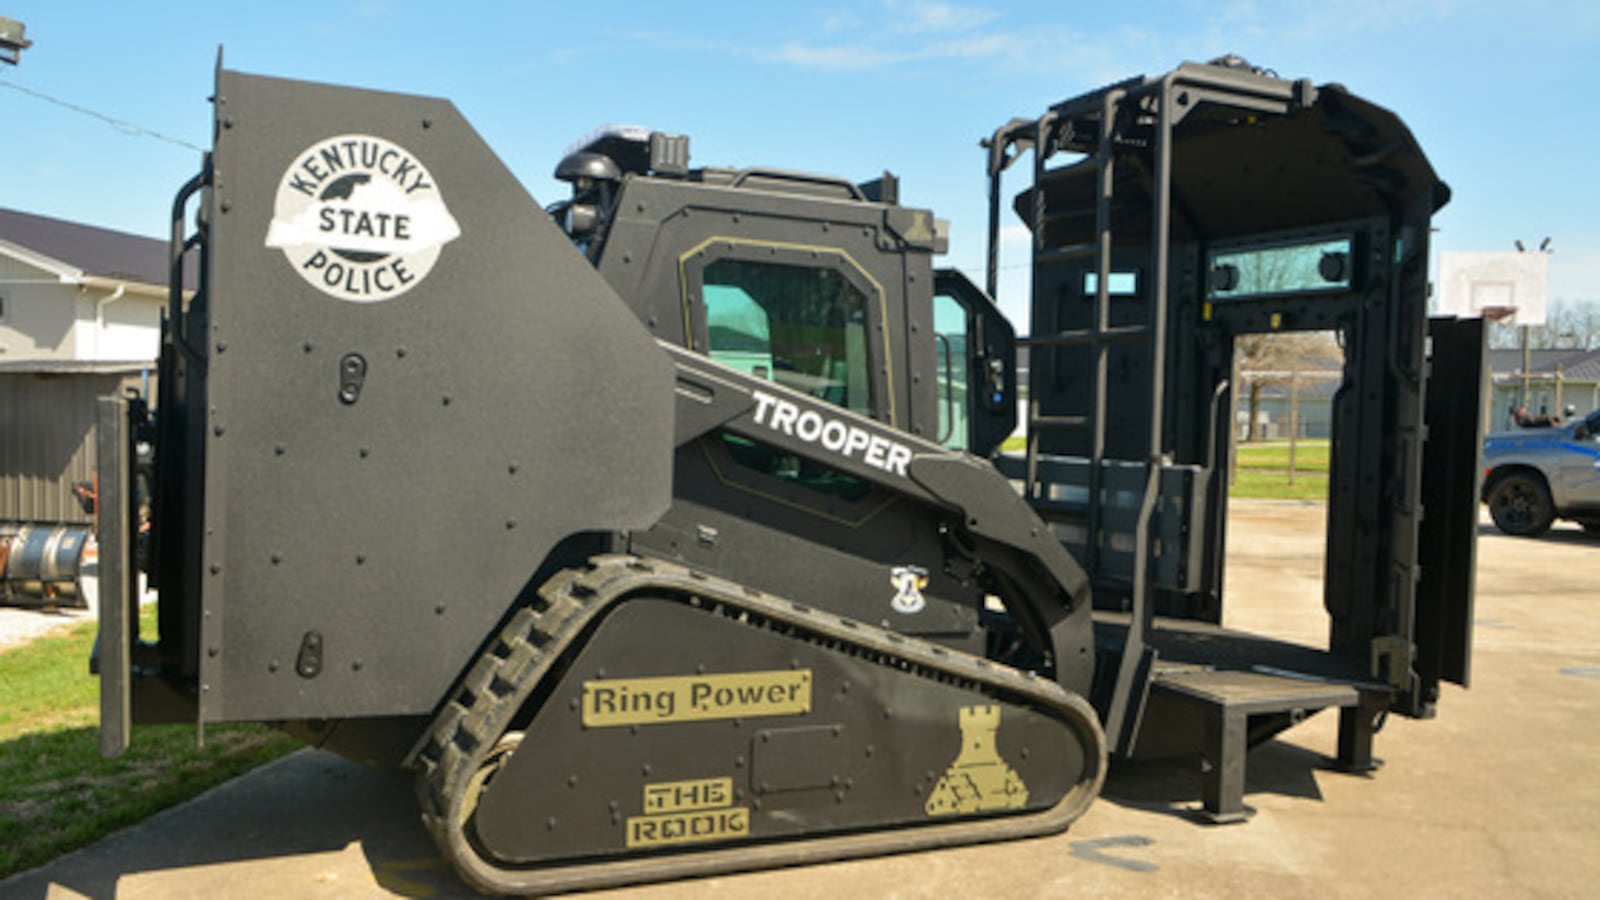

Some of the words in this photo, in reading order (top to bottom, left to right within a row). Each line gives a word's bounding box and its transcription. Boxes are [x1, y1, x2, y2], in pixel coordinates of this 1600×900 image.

[288, 140, 431, 197] KENTUCKY
[319, 207, 411, 240] STATE
[303, 250, 415, 295] POLICE
[752, 390, 913, 476] TROOPER
[593, 686, 676, 718] Ring
[690, 682, 801, 708] Power
[649, 782, 725, 808] THE
[633, 812, 745, 841] ROOK
